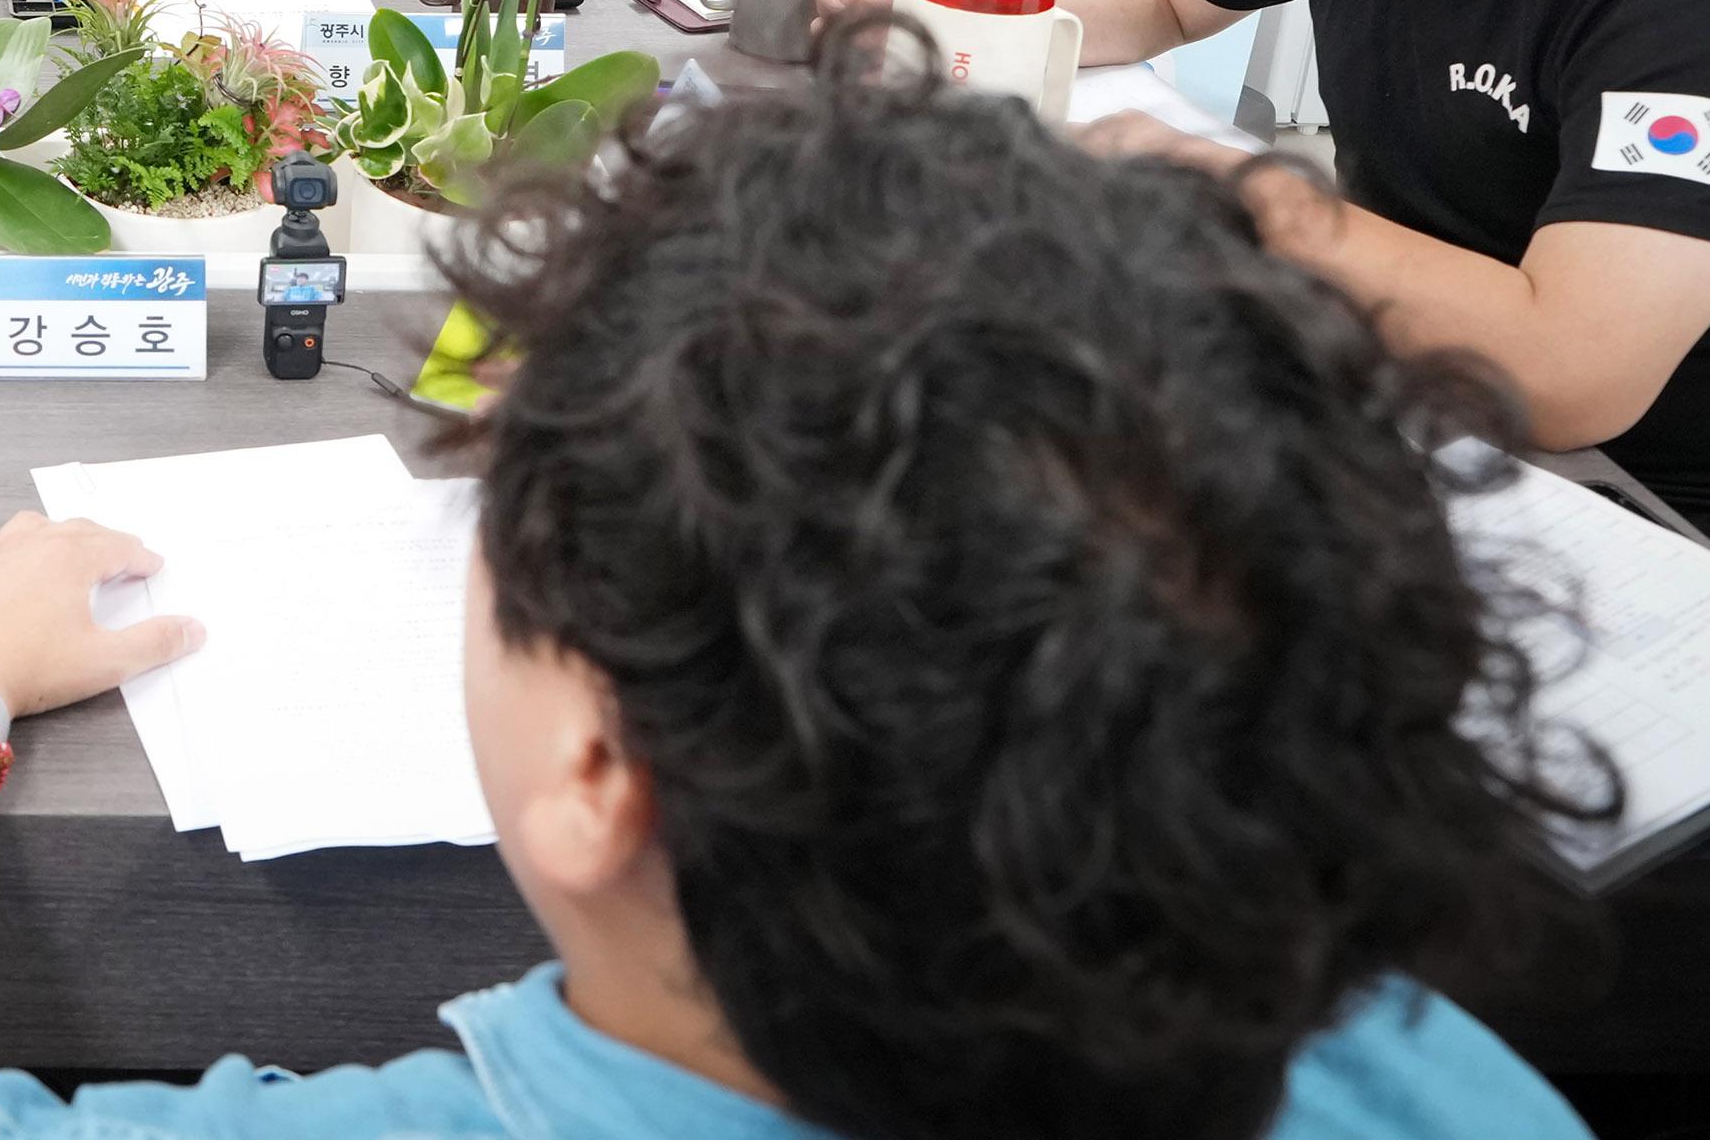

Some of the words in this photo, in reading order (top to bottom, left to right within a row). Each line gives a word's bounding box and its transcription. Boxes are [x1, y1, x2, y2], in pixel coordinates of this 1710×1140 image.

[320, 23, 364, 39] 광주시
[951, 52, 972, 86] HO
[146, 266, 196, 297] 광주
